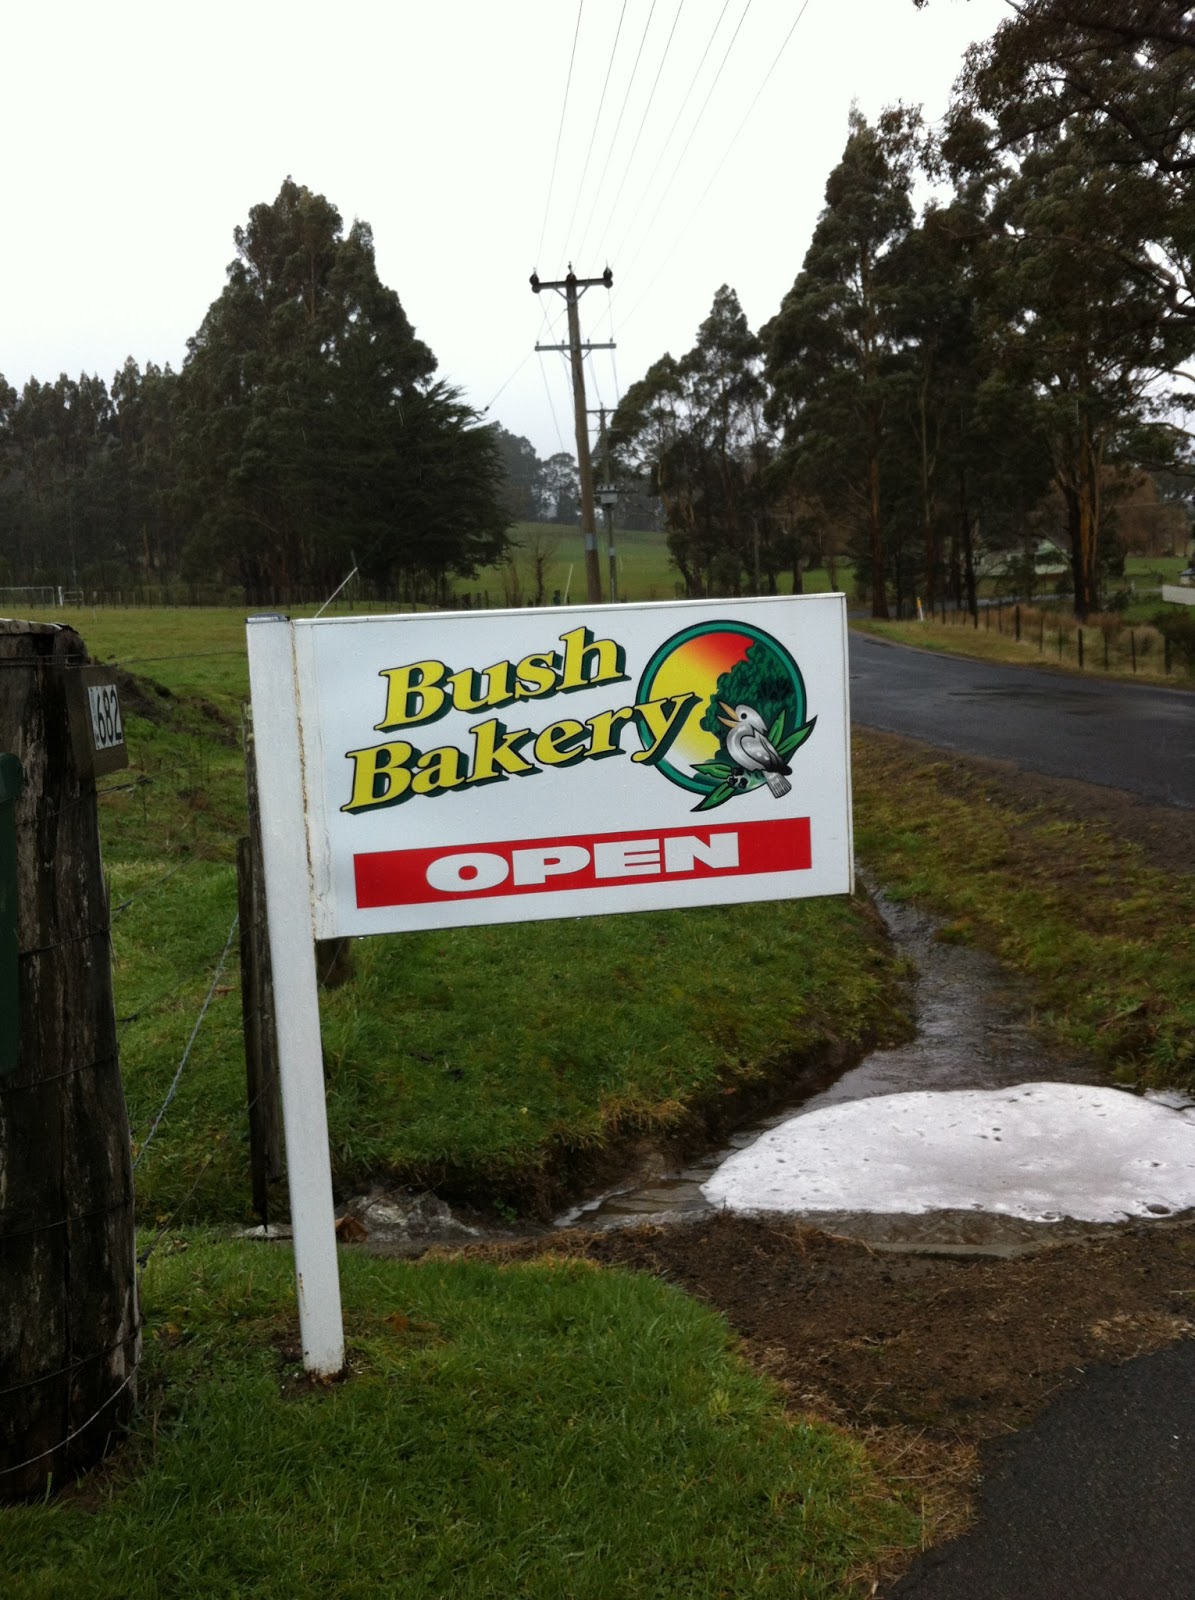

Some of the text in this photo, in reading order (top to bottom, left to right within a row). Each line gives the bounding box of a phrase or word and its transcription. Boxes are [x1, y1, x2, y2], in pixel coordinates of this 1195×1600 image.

[97, 688, 122, 745] 682
[374, 626, 631, 733] Bush
[340, 692, 704, 815] Bakery
[425, 832, 739, 893] OPEN
